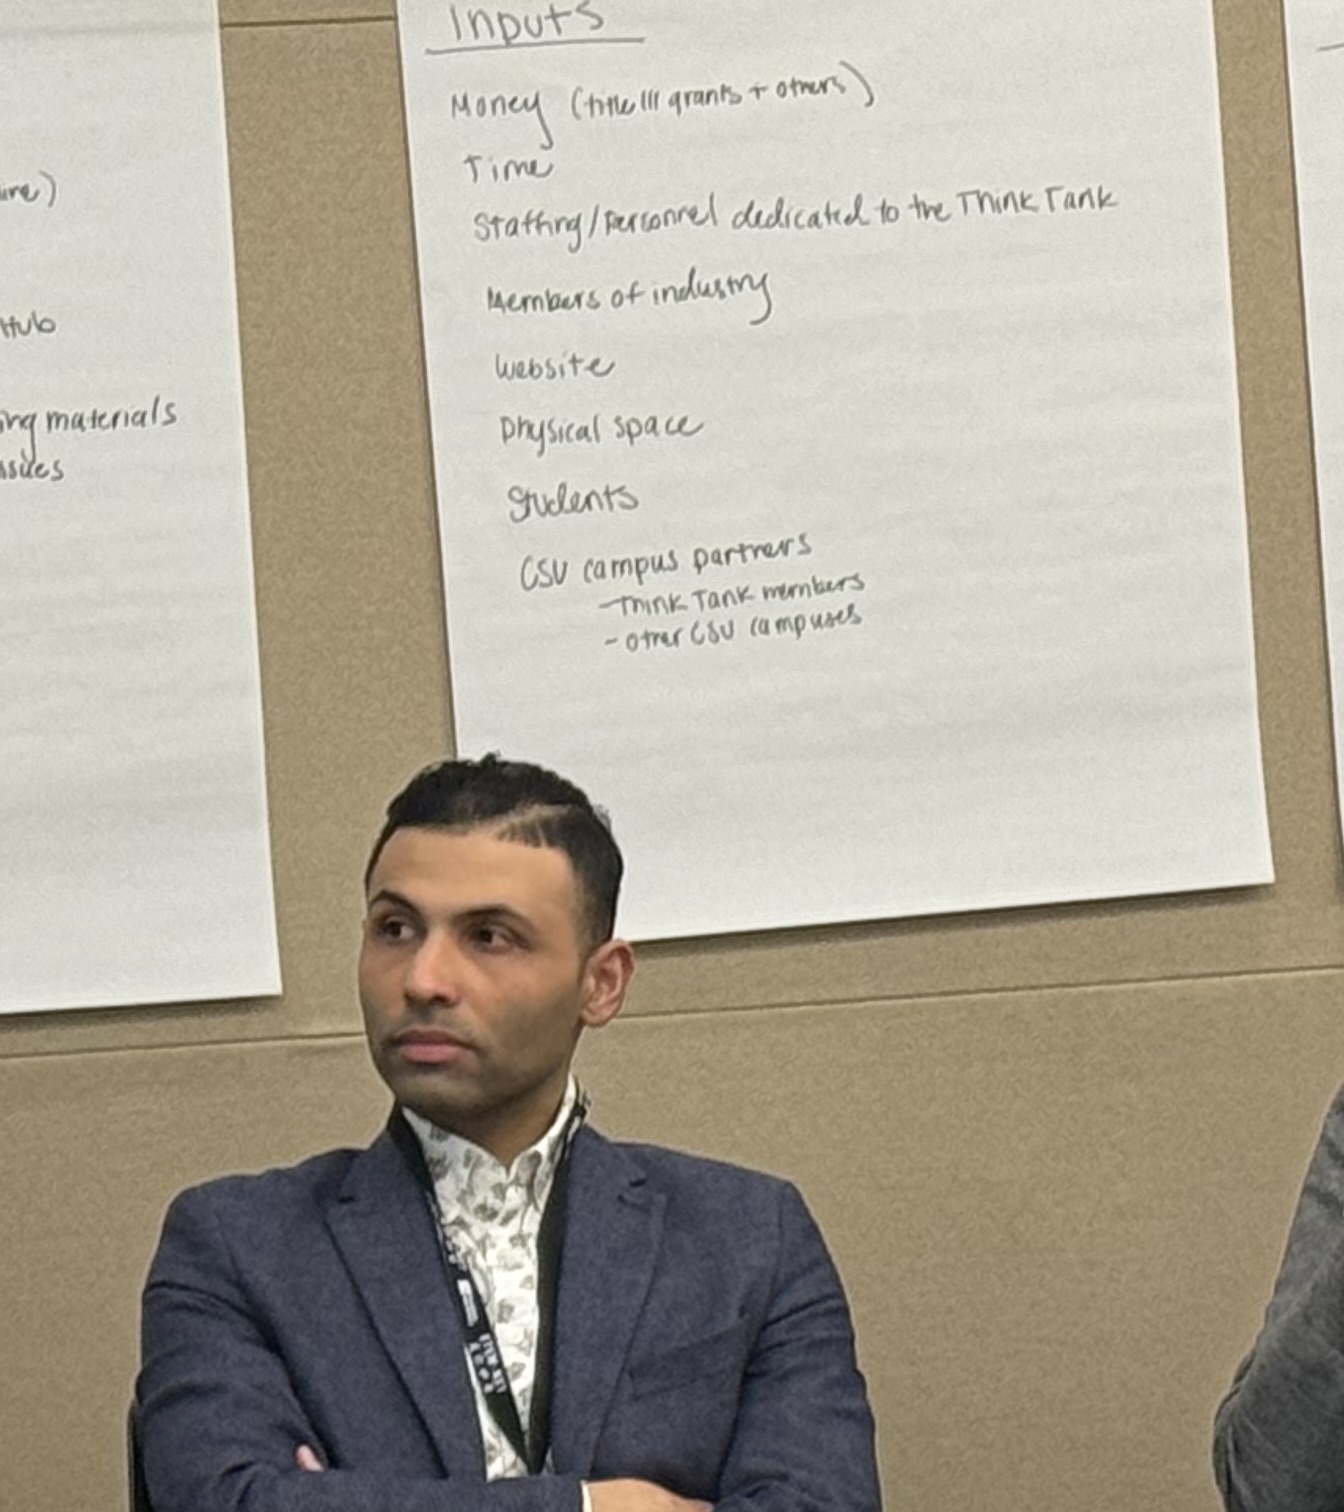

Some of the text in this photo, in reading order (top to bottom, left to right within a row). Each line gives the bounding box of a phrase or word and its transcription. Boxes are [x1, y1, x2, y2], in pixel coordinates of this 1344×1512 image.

[449, 0, 606, 45] Inputs
[450, 90, 555, 150] Money
[463, 154, 555, 184] Time
[731, 192, 871, 231] dedicated
[875, 197, 901, 225] to
[908, 192, 954, 223] the
[1044, 184, 1120, 214] Tank
[610, 280, 646, 308] of
[652, 265, 773, 327] industry
[0, 310, 58, 338] Hub
[46, 394, 180, 432] materials
[613, 413, 705, 447] space
[520, 531, 813, 592] CSU campus partners
[695, 585, 756, 614] Tank
[689, 618, 736, 647] CSU
